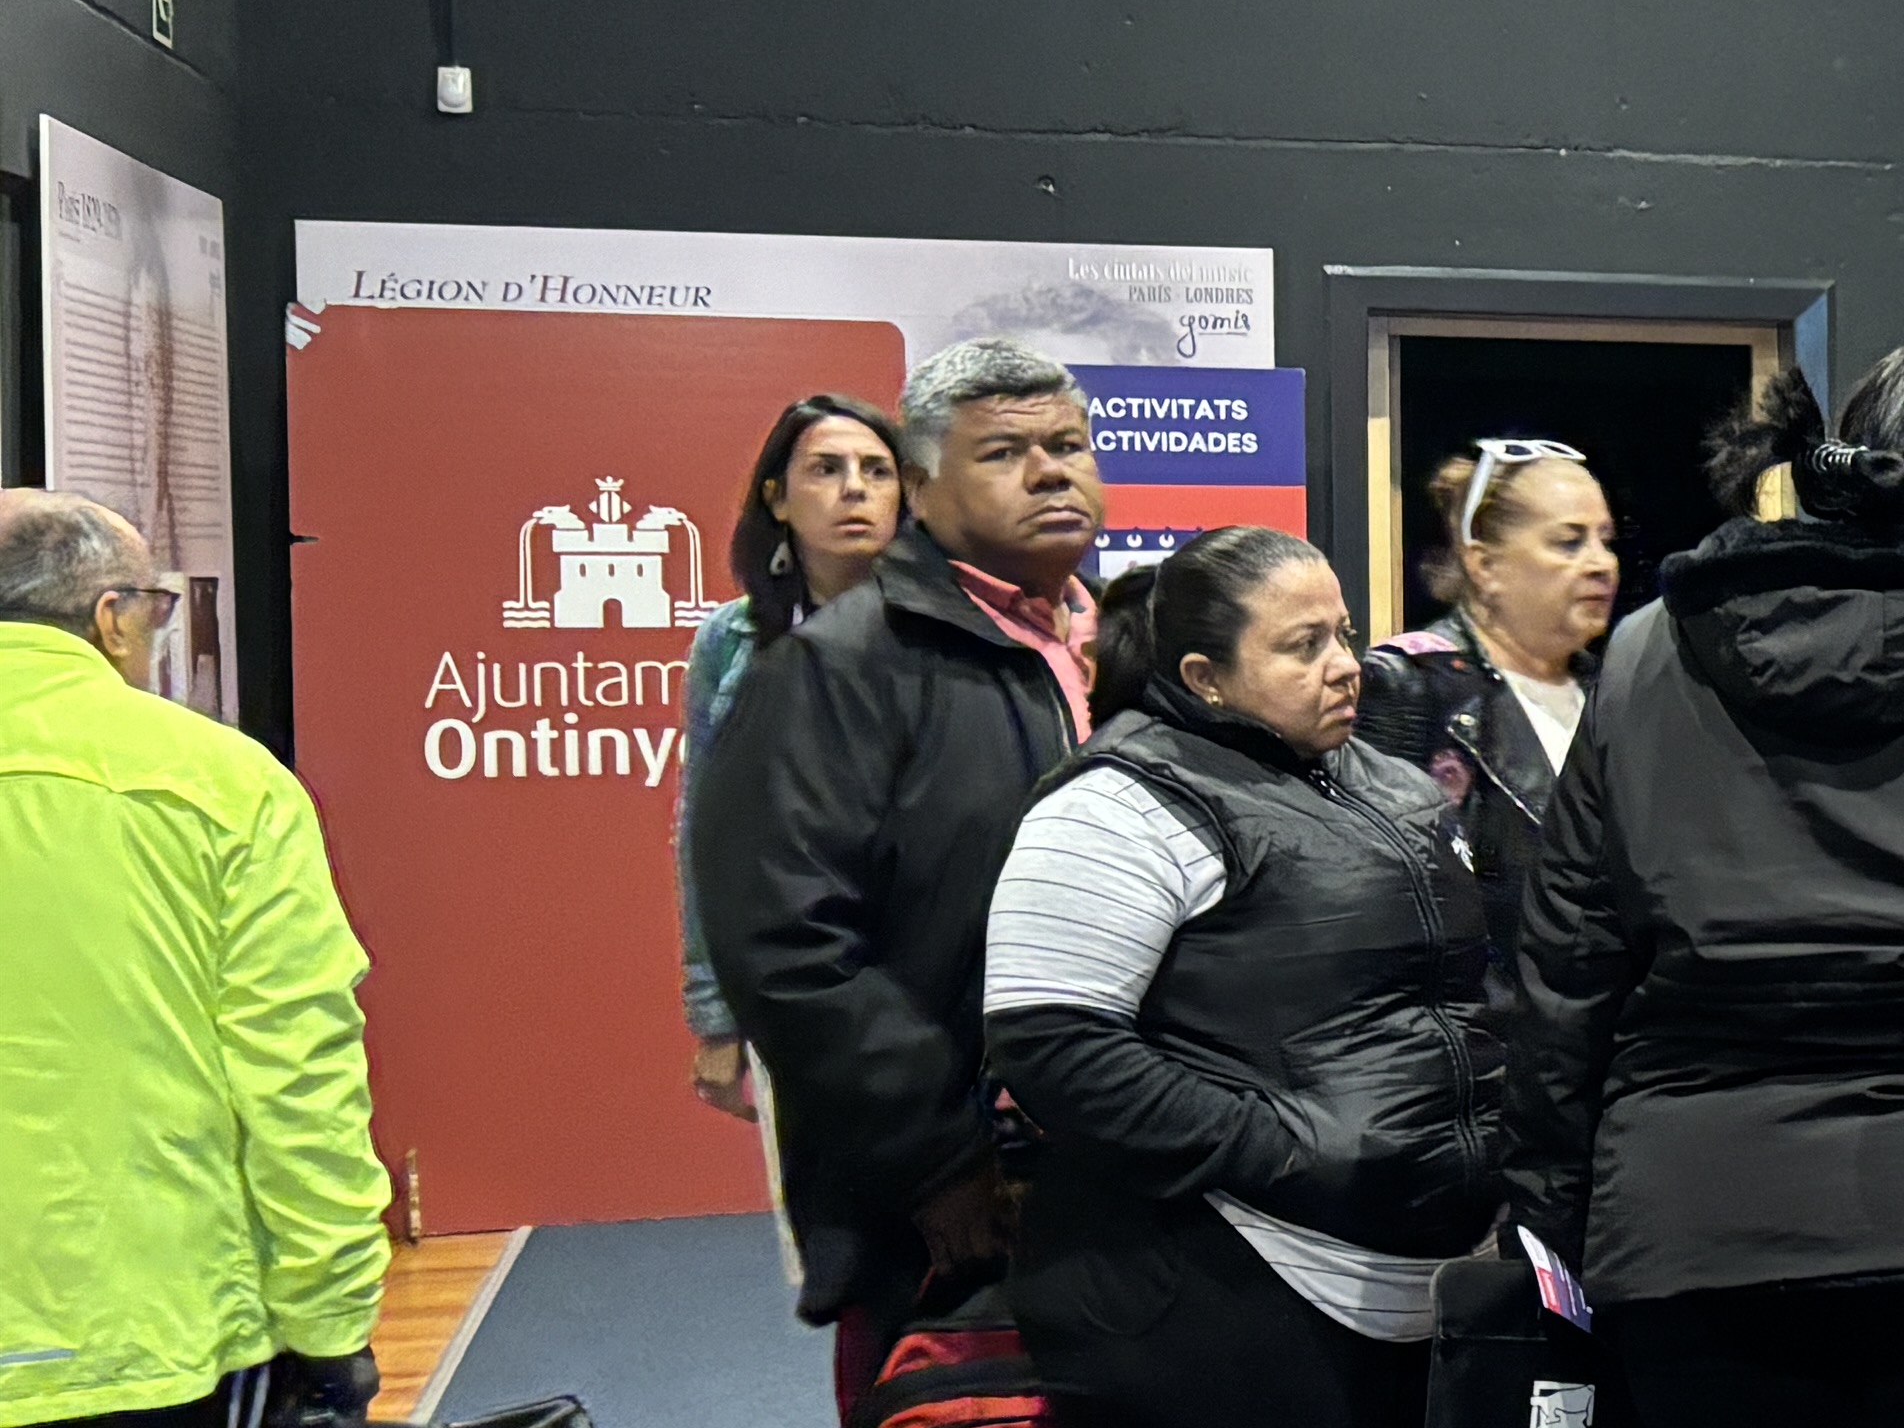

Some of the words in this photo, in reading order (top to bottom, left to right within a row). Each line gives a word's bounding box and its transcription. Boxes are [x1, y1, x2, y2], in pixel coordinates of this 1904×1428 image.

[1184, 286, 1254, 305] LONDRES
[1088, 397, 1248, 421] ACTIVITATS
[424, 712, 687, 788] Ontiny
